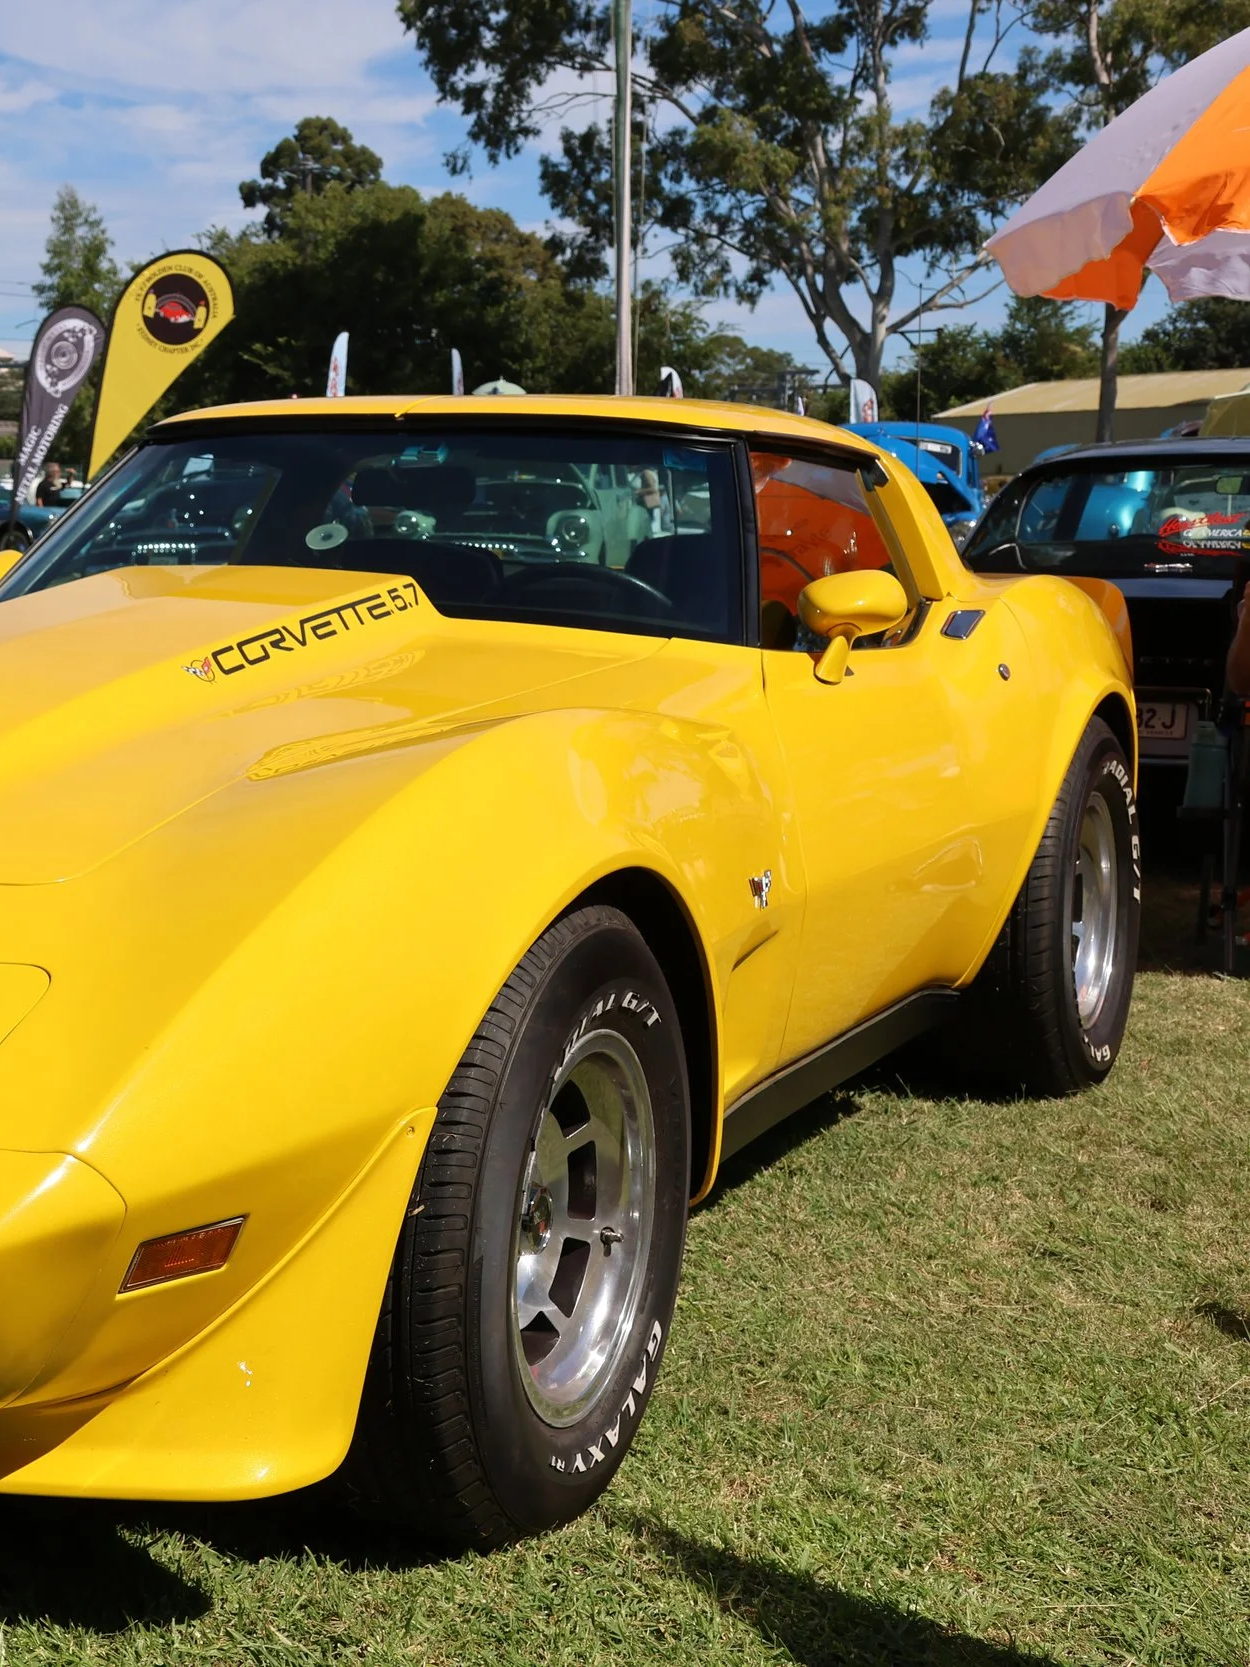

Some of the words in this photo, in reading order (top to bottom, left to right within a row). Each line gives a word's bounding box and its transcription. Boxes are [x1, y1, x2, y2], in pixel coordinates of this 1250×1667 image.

[174, 264, 194, 274] CLUB
[203, 279, 219, 319] AUSTRALIA
[14, 464, 41, 506] METAL
[31, 403, 69, 469] MOTORING
[18, 425, 42, 467] MAGIC
[1200, 528, 1242, 537] MERICA
[211, 593, 392, 676] CORVETTE
[387, 582, 420, 614] 5.7
[622, 991, 662, 1027] G/T
[571, 1320, 663, 1474] GALAXY
